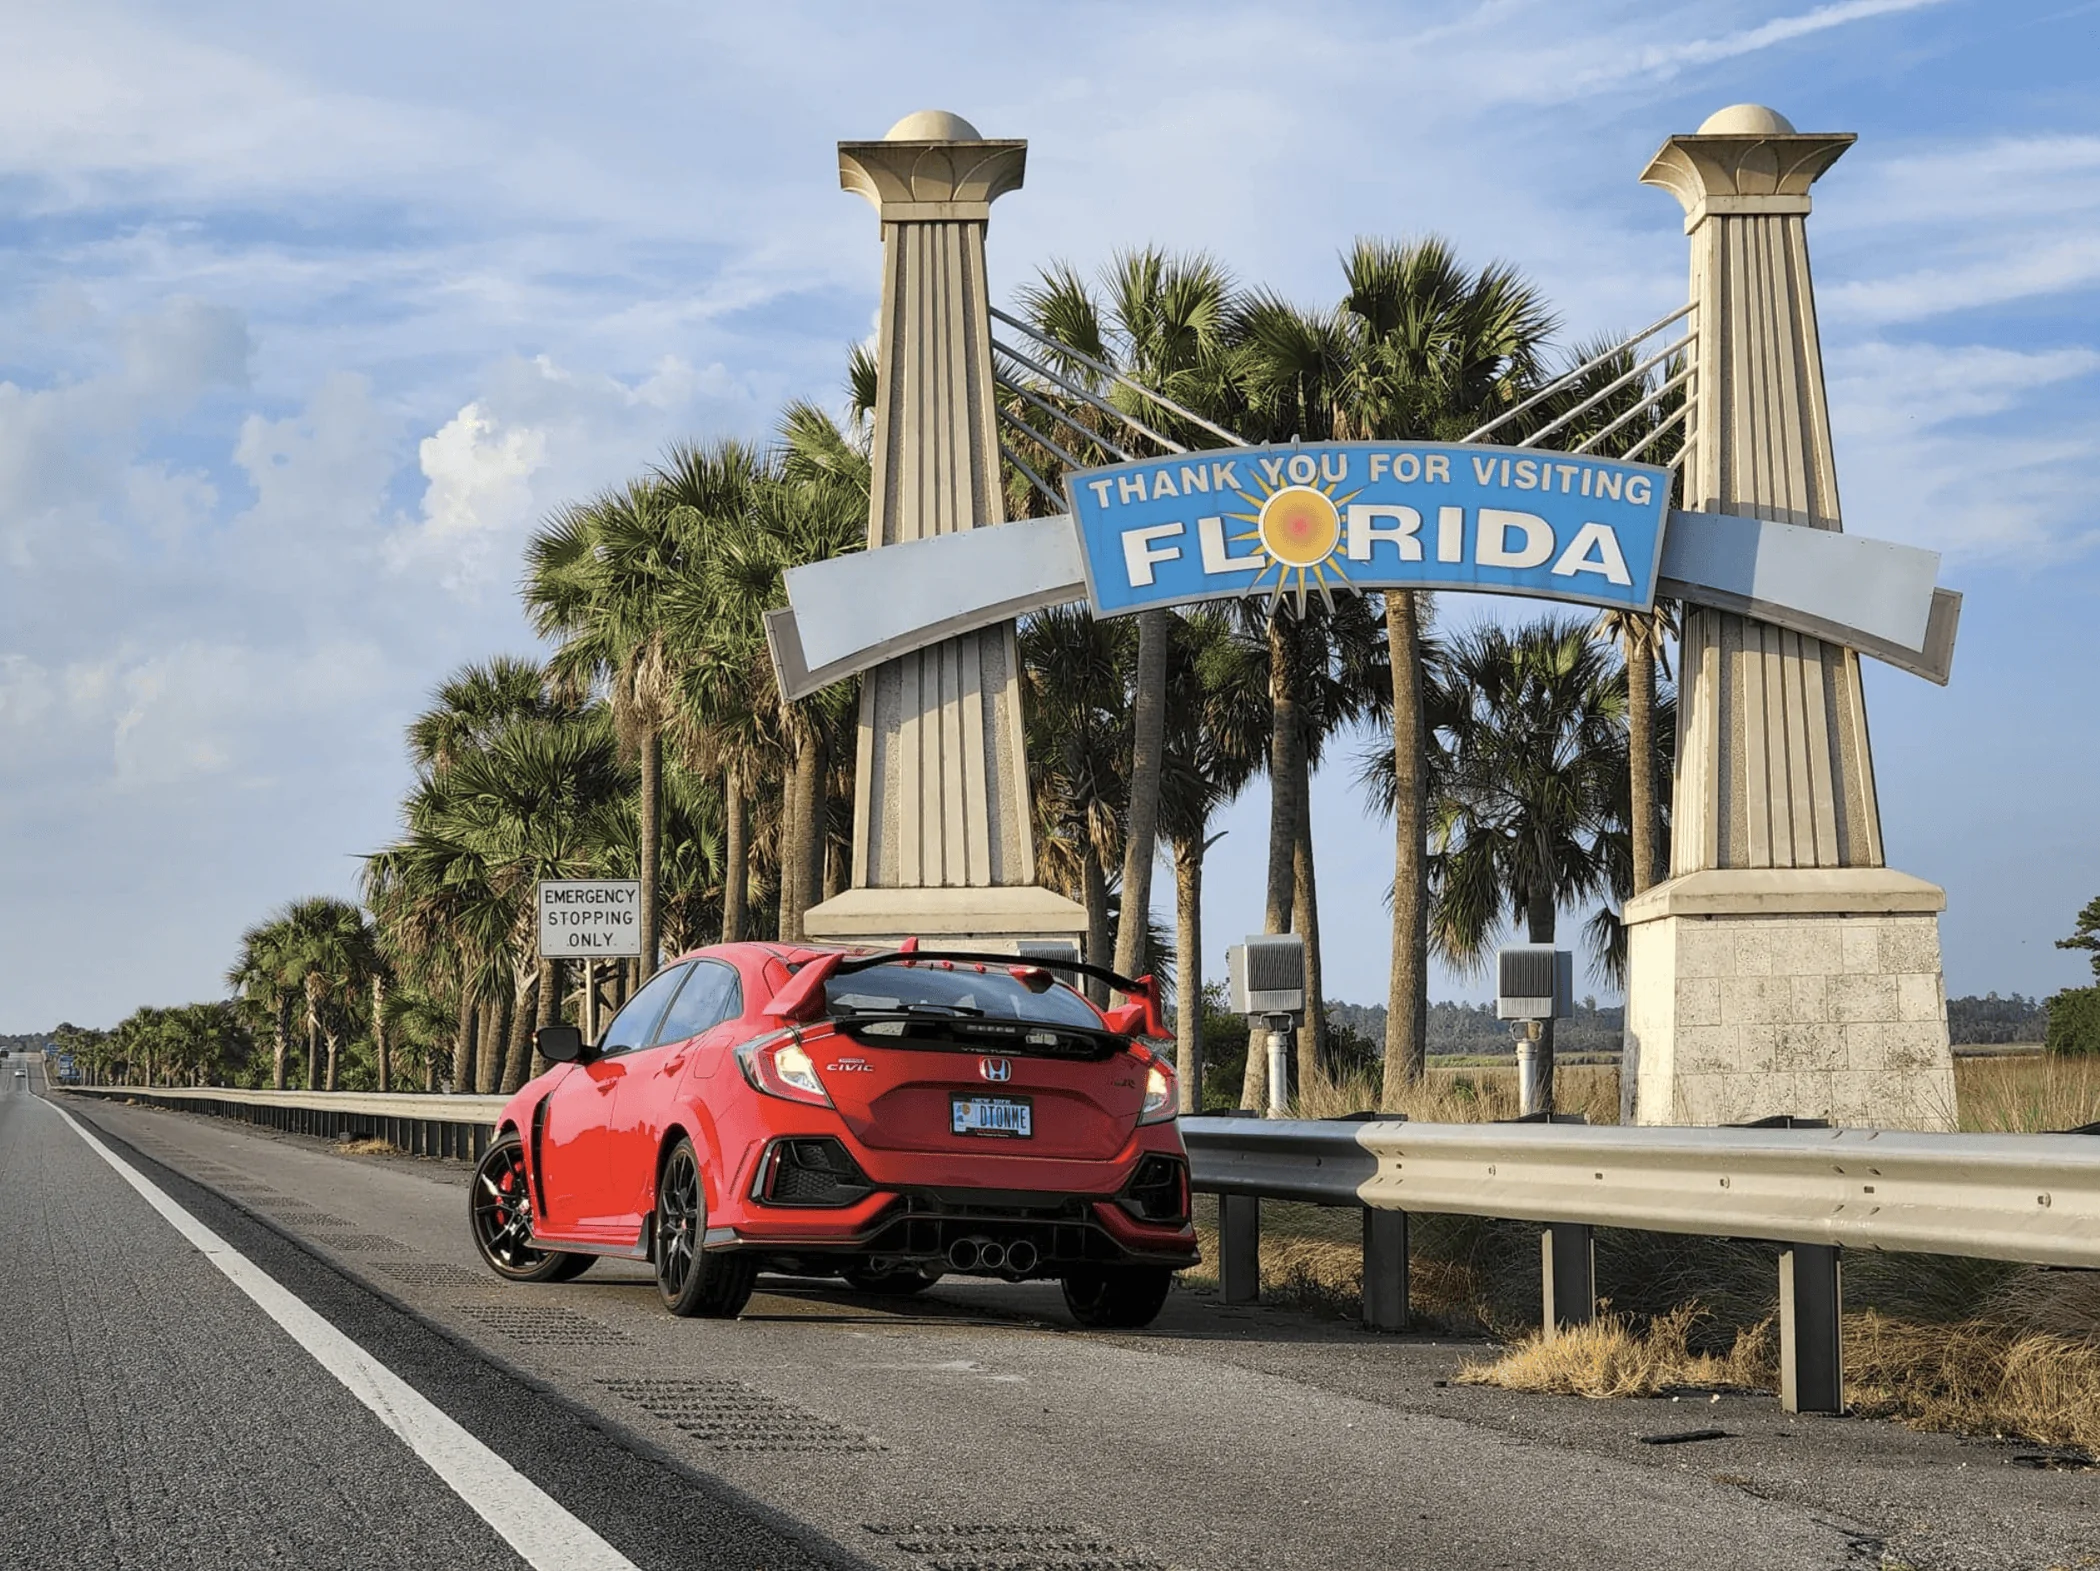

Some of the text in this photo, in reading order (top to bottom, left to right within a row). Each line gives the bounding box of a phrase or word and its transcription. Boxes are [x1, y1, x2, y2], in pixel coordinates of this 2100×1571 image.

[1088, 453, 1653, 509] THANK YOU FOR VISITING
[1121, 505, 1632, 587] FLORIDA
[545, 889, 636, 904] EMERGENCY
[548, 911, 633, 926] STOPPING
[569, 932, 614, 947] ONLY
[826, 1063, 874, 1072] CIVIC
